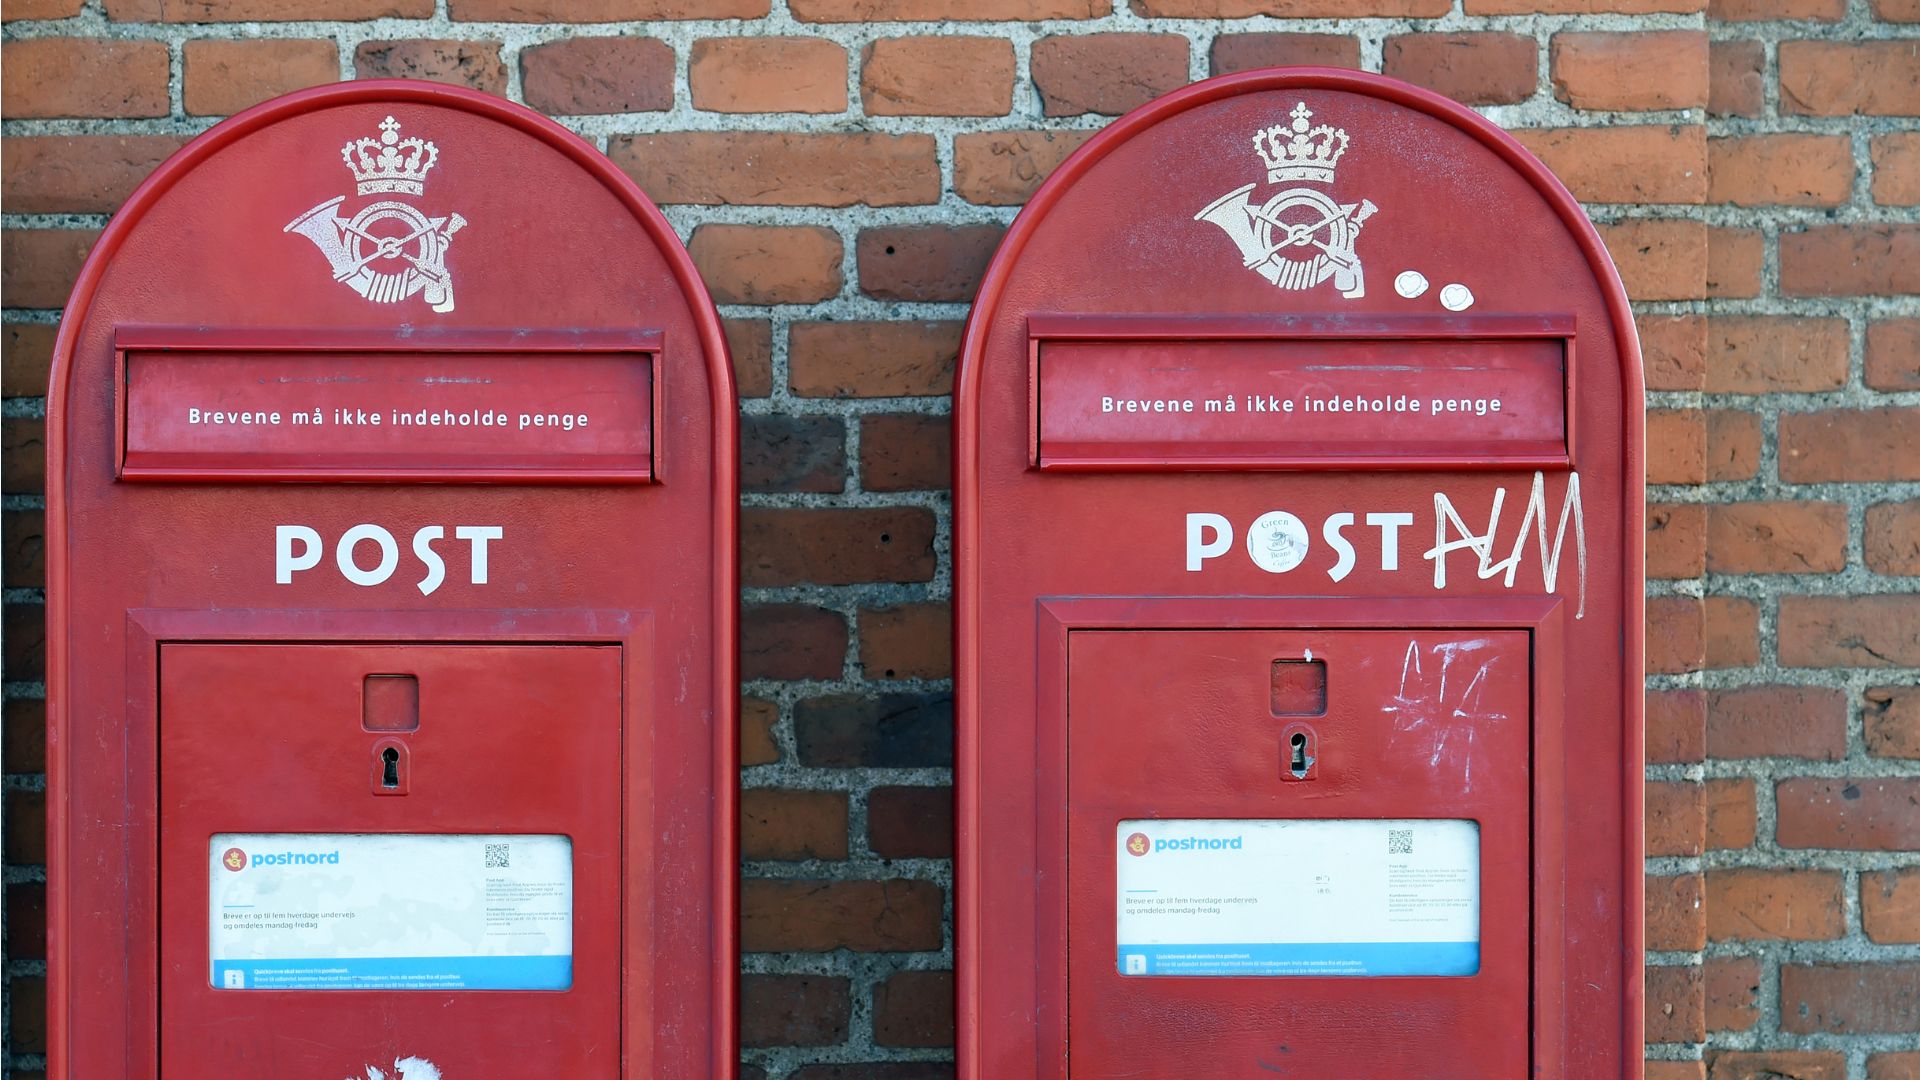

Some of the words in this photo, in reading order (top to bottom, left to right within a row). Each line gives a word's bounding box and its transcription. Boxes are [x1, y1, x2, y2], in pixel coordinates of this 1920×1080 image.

[1101, 396, 1194, 414] Brevene
[1204, 394, 1236, 413] må
[1247, 394, 1294, 412] ikke
[1304, 394, 1421, 413] indeholde
[1431, 398, 1502, 418] penge
[188, 407, 281, 425] Brevene
[292, 406, 323, 425] må
[334, 408, 382, 426] ikke
[392, 408, 508, 427] indeholde
[518, 412, 588, 431] penge
[1261, 519, 1289, 529] Green
[1186, 510, 1415, 583] PST
[275, 523, 503, 597] POST
[1155, 837, 1242, 853] postnord
[251, 850, 339, 868] postnord
[1156, 898, 1165, 906] op
[1189, 897, 1223, 905] hverdage
[1223, 897, 1258, 905] undervejs
[287, 912, 320, 920] hverdage
[320, 911, 356, 920] undervejs
[1136, 906, 1166, 914] omdeles
[234, 921, 264, 929] omdeles
